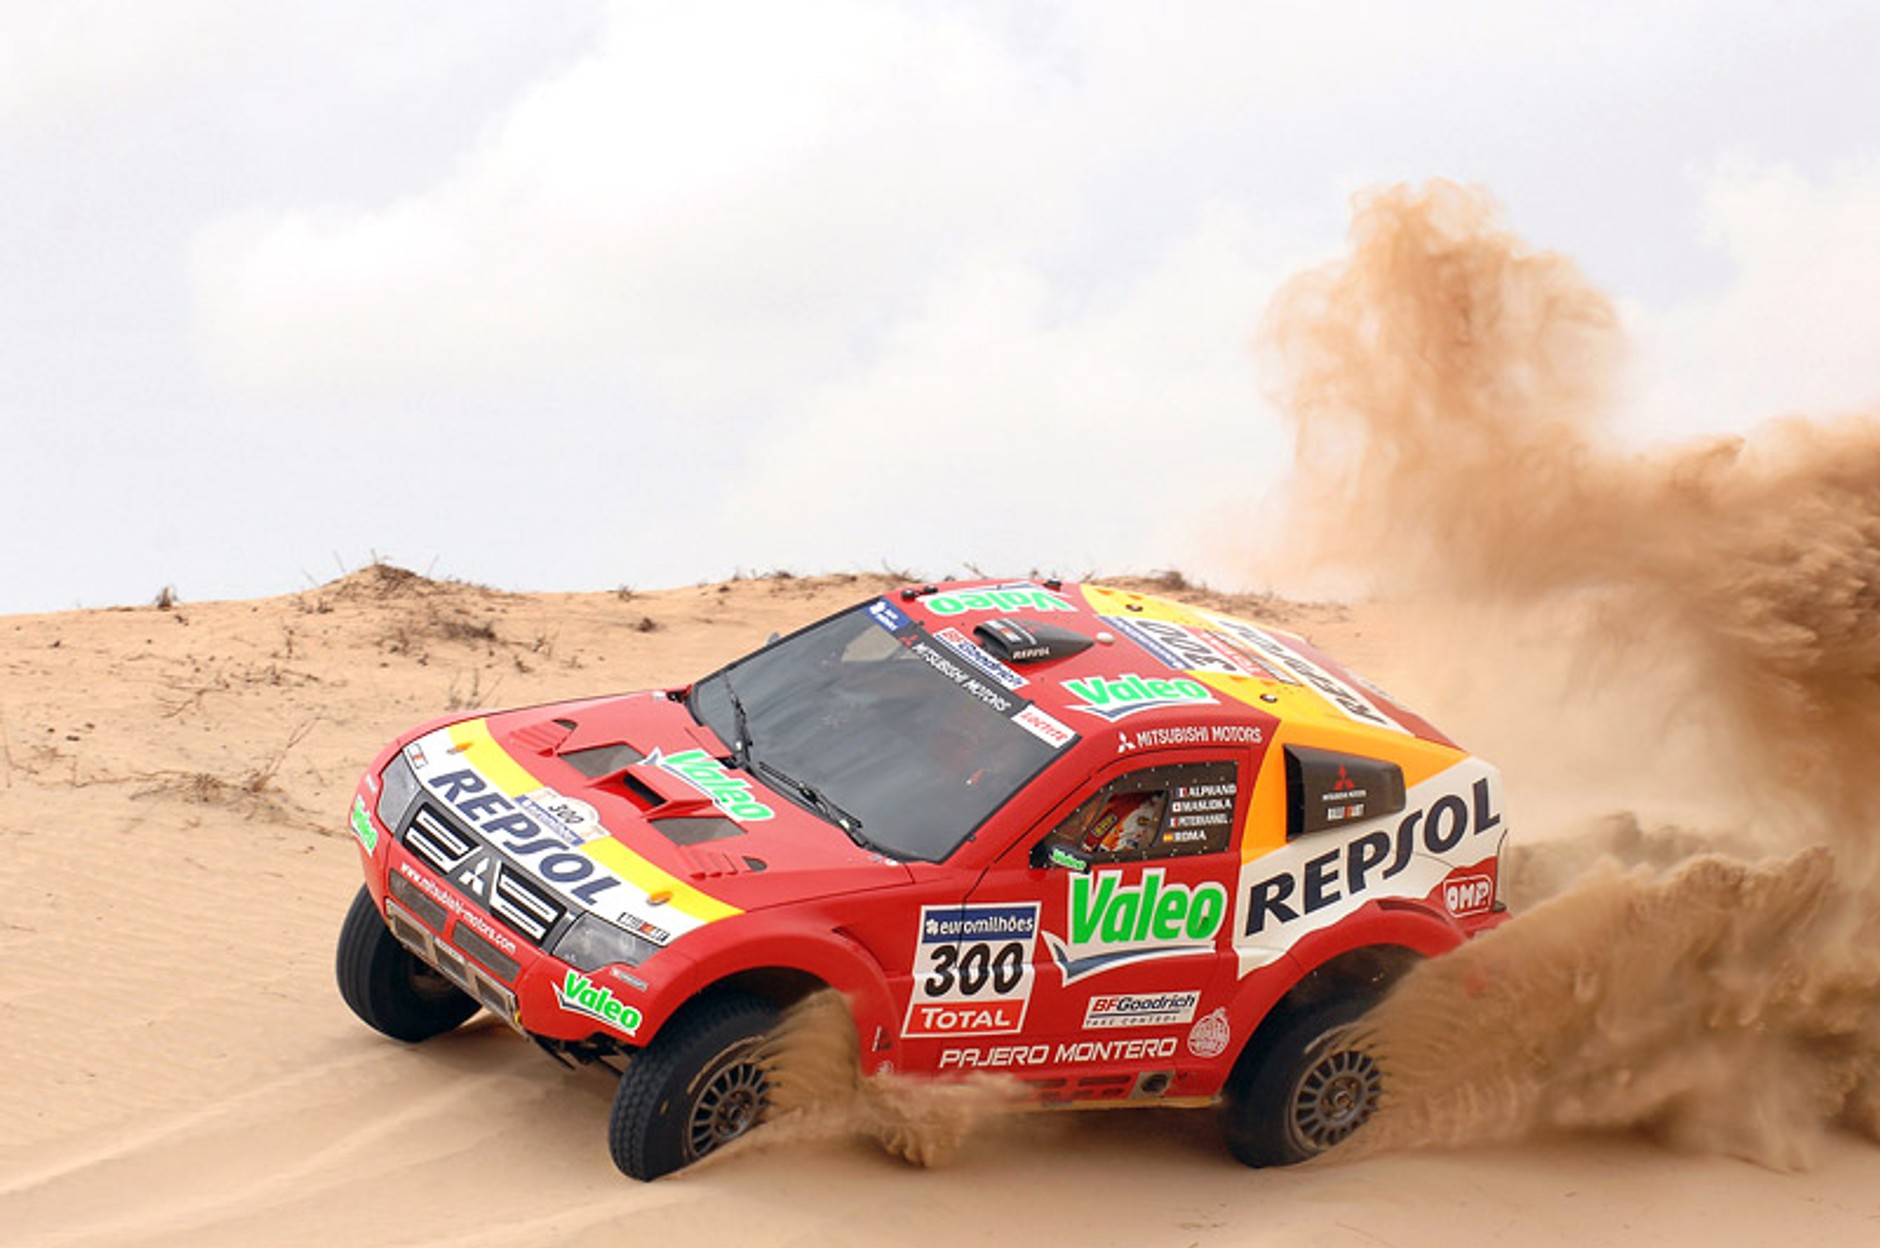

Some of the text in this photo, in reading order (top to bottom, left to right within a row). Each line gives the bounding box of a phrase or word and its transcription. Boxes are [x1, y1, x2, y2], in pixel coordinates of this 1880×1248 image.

[927, 590, 1074, 614] Valeo
[912, 642, 969, 684] MITSUBISHI
[961, 678, 1012, 711] MOTORS
[1065, 675, 1210, 705] Valeo
[1136, 726, 1263, 748] MITSUBISHI MOTORS
[663, 750, 774, 819] Valeo
[1188, 784, 1237, 797] ALPHAND
[547, 804, 585, 824] 300
[428, 768, 623, 907] REPSOL
[1174, 831, 1207, 842] ROMA
[1244, 777, 1501, 937] REPSOL
[1072, 874, 1225, 944] Valeo
[1445, 880, 1490, 912] OMP
[939, 916, 1033, 935] euromilhões
[924, 941, 1024, 997] 300
[565, 971, 641, 1029] Valeo
[1092, 994, 1196, 1012] BFGoodrich
[921, 1007, 1011, 1029] TOTAL
[938, 1038, 1179, 1069] PAJERO MONTERO
